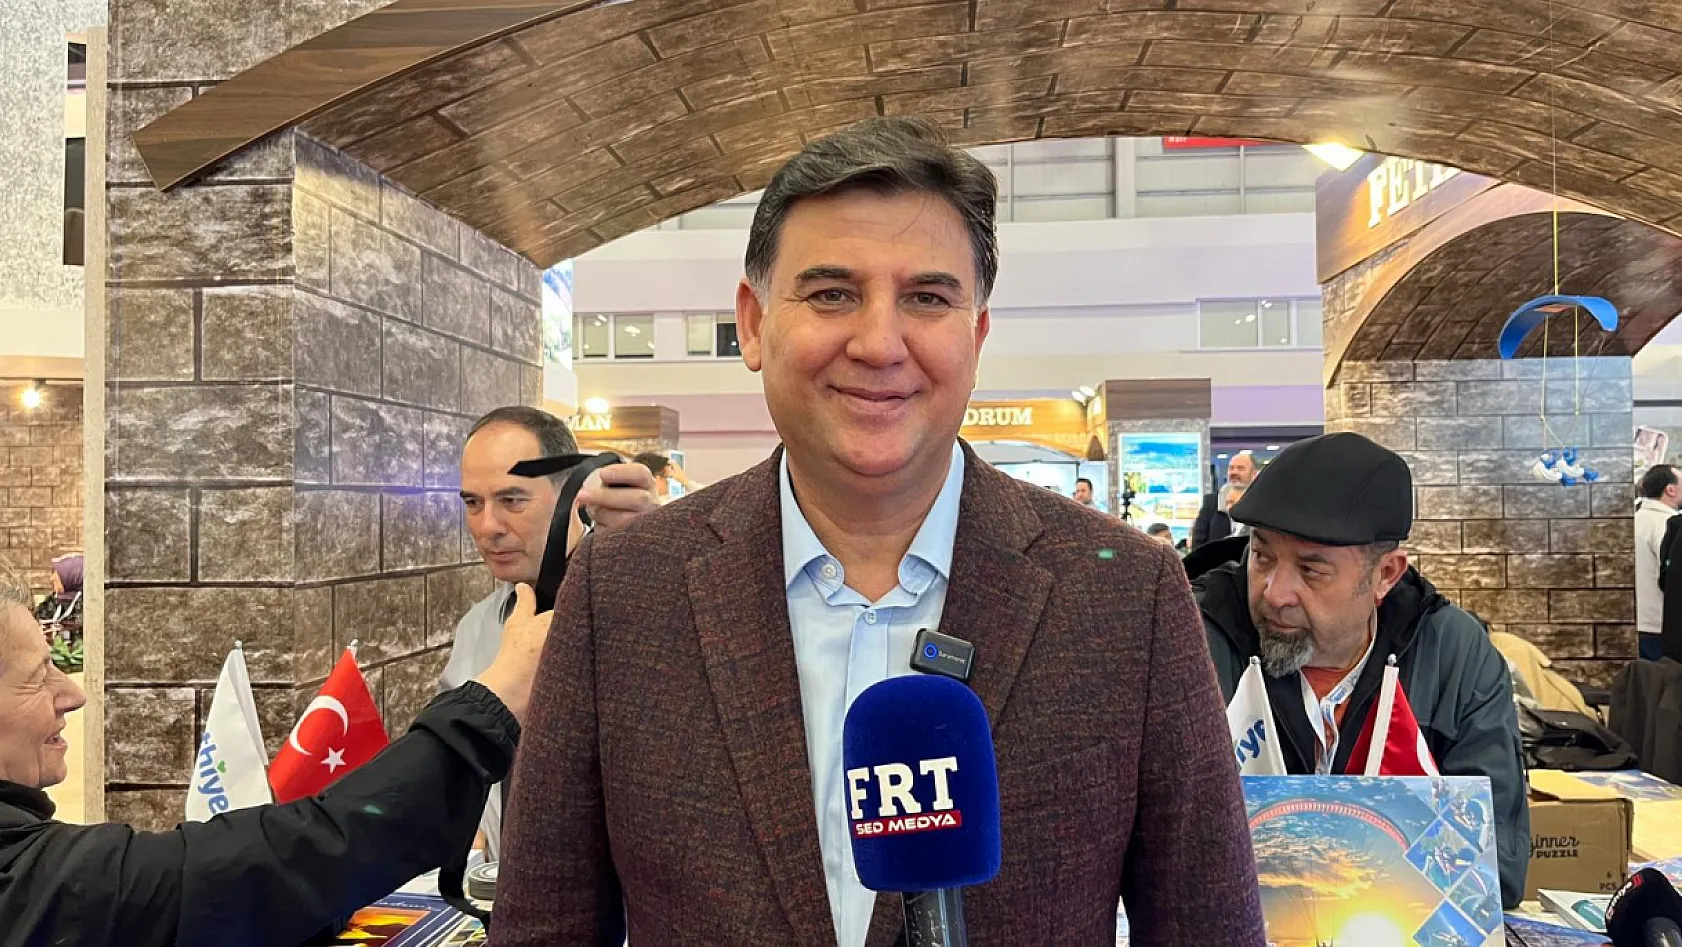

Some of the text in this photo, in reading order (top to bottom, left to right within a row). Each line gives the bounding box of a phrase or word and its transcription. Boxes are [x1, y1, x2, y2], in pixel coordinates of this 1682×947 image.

[847, 756, 958, 820] FRT
[856, 813, 957, 835] SED MEDYA
[1536, 849, 1578, 860] PUZZLE
